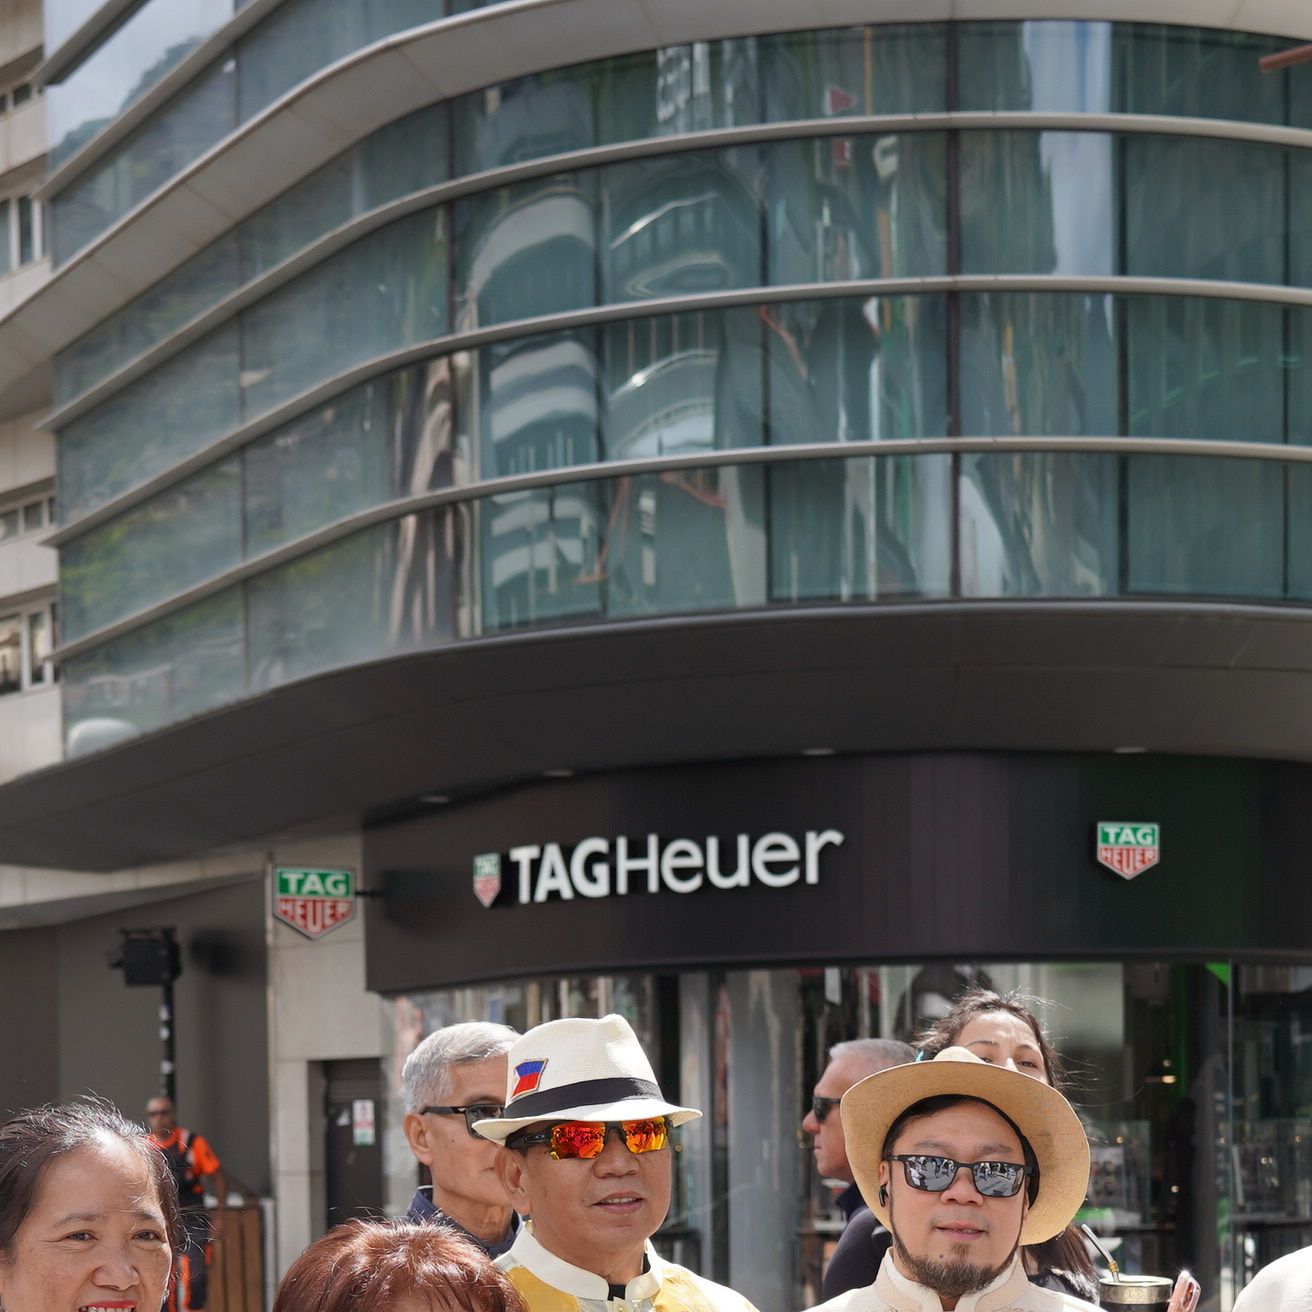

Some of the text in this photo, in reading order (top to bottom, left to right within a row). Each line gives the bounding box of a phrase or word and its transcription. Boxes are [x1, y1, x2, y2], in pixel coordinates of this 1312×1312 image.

[1103, 827, 1154, 846] TAG
[1100, 847, 1158, 876] HEUER
[281, 872, 348, 896] TAG
[278, 898, 352, 932] HEUER
